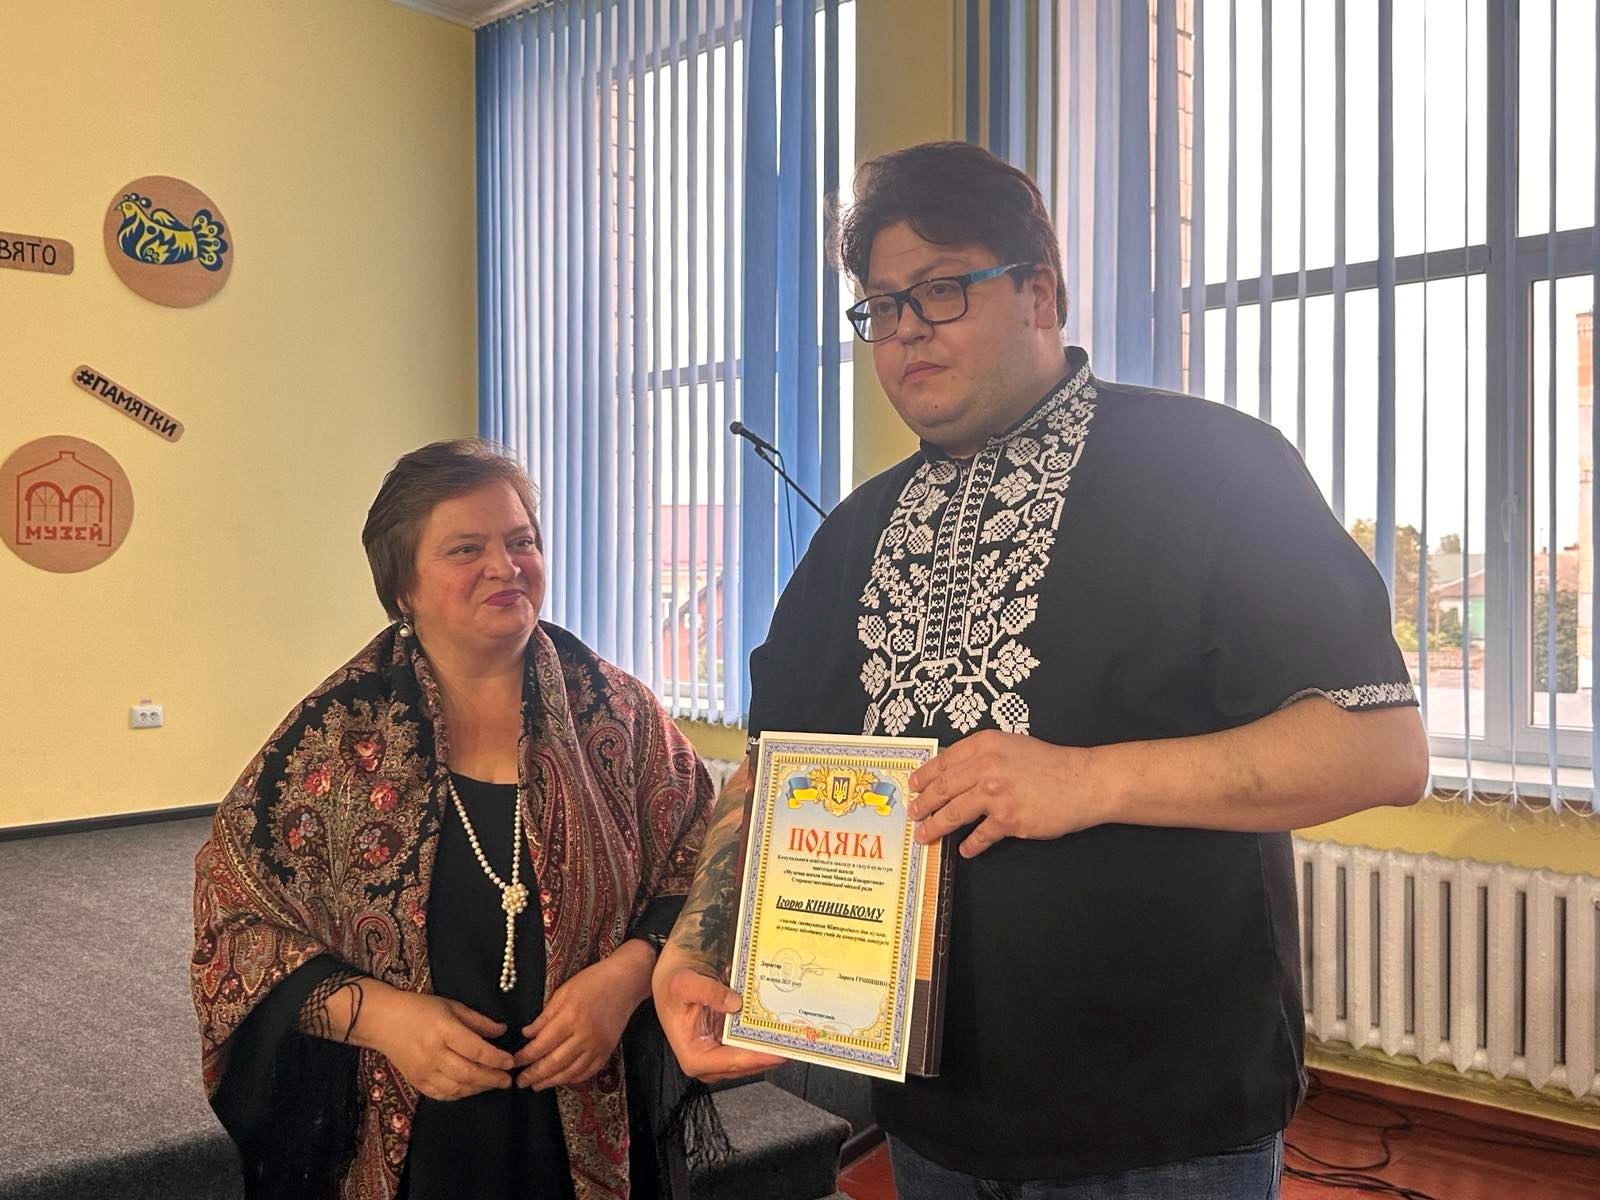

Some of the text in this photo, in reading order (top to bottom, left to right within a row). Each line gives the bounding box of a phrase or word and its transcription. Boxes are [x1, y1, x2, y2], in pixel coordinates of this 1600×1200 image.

[25, 523, 103, 541] МУЗЕЙ
[788, 827, 884, 859] ПОДЯКА
[776, 895, 885, 921] Ігорю КІНИЦЬКОМУ
